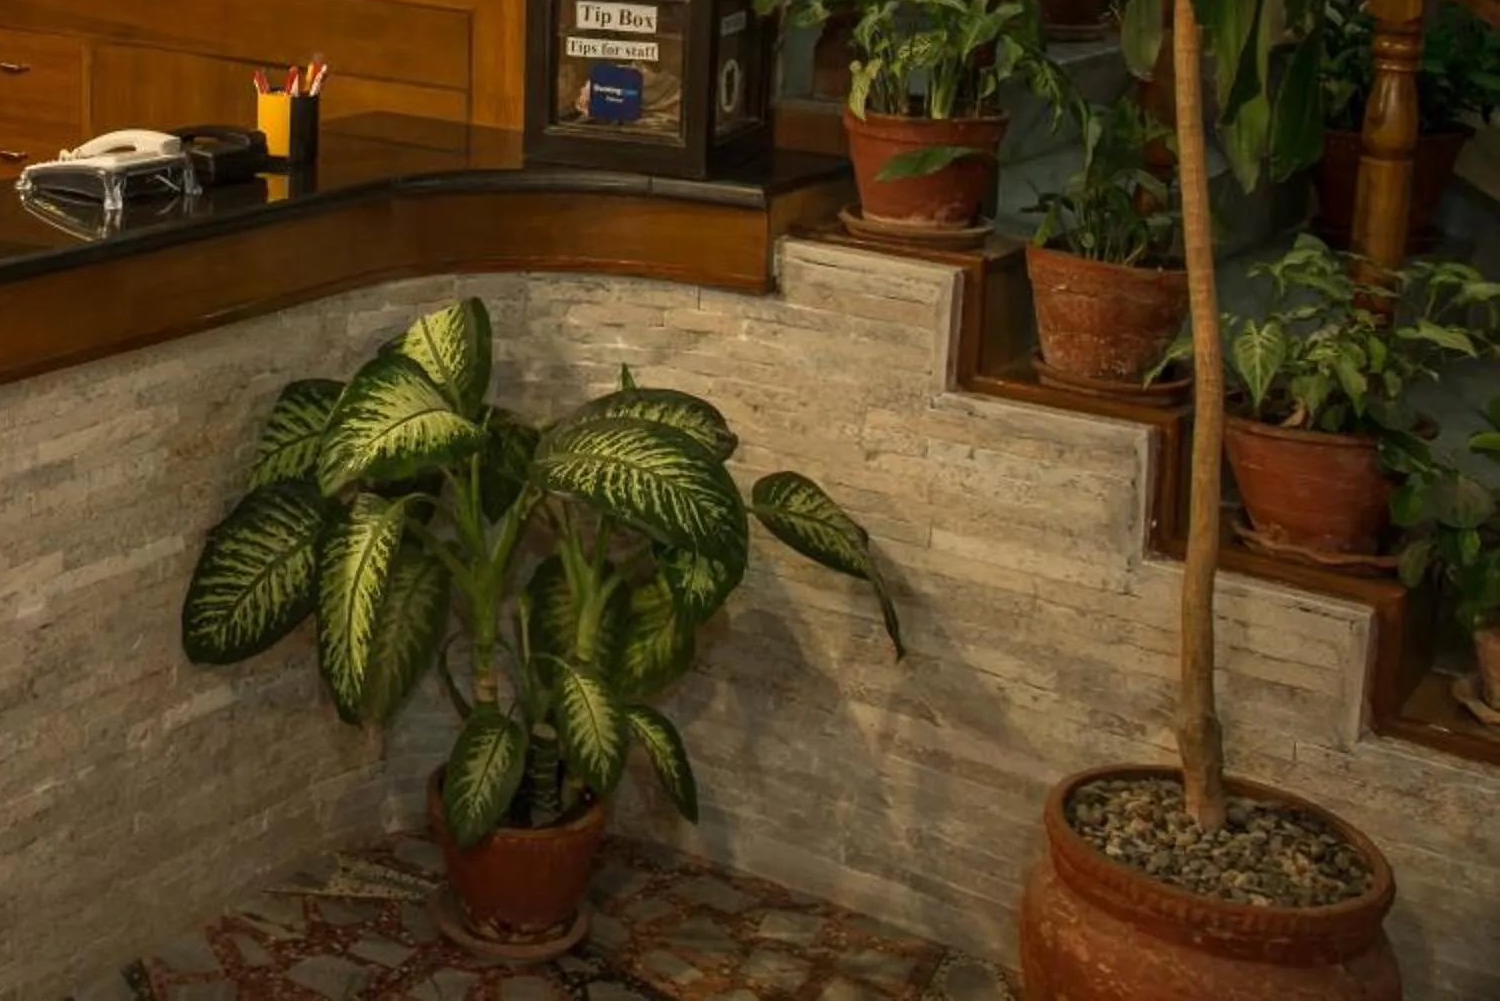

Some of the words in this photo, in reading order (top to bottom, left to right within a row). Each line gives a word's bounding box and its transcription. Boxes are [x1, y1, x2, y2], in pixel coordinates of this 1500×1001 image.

[580, 4, 611, 26] Tip
[619, 8, 655, 29] Box
[569, 40, 598, 56] Tips
[601, 41, 620, 56] for
[625, 44, 656, 59] staff
